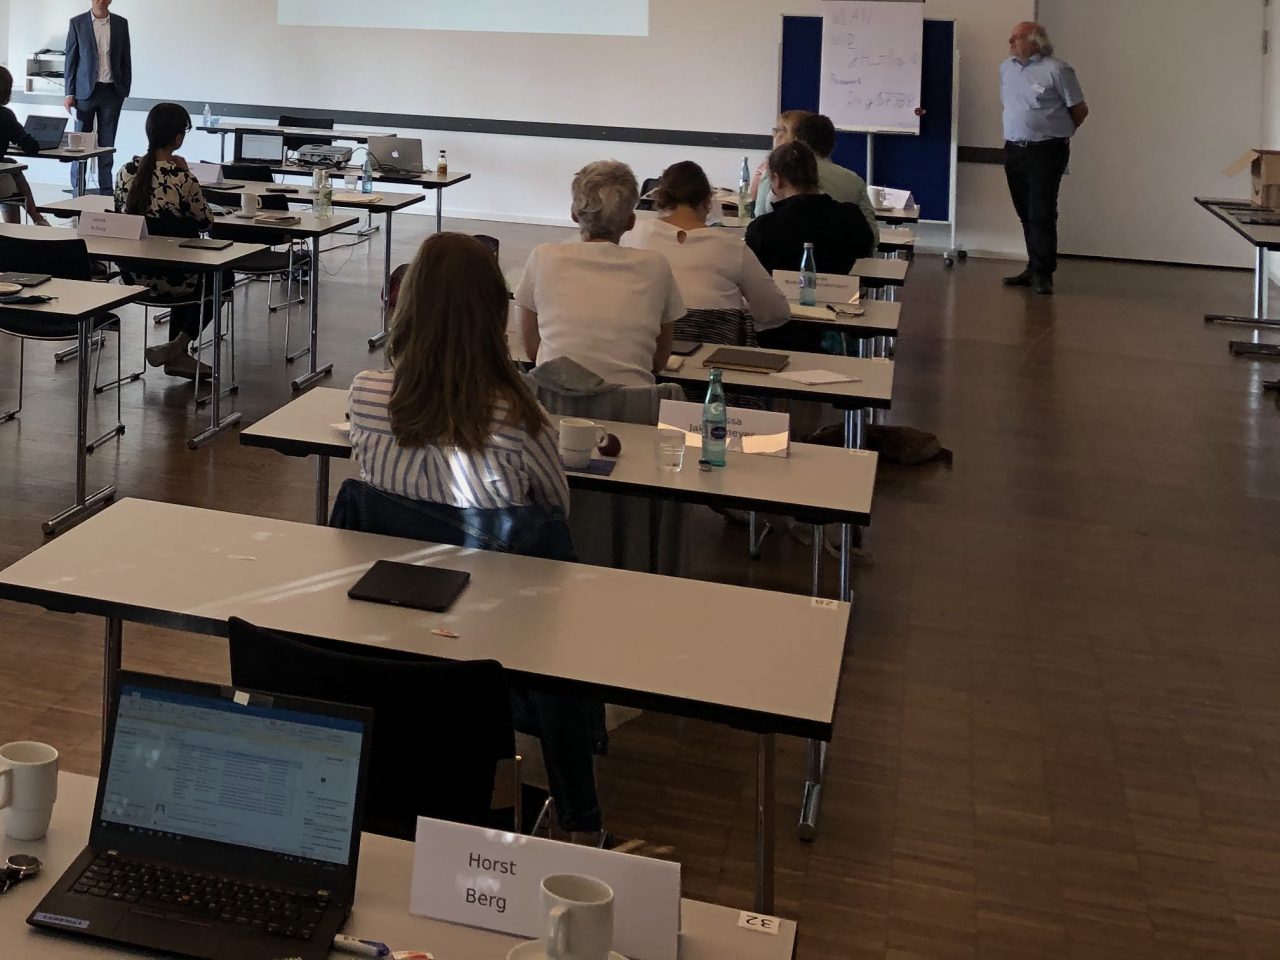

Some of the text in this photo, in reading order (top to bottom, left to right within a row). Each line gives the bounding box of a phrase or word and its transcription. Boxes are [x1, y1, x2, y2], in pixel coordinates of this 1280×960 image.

[468, 851, 518, 876] Horst
[465, 887, 508, 913] Berg
[745, 914, 774, 929] 32
